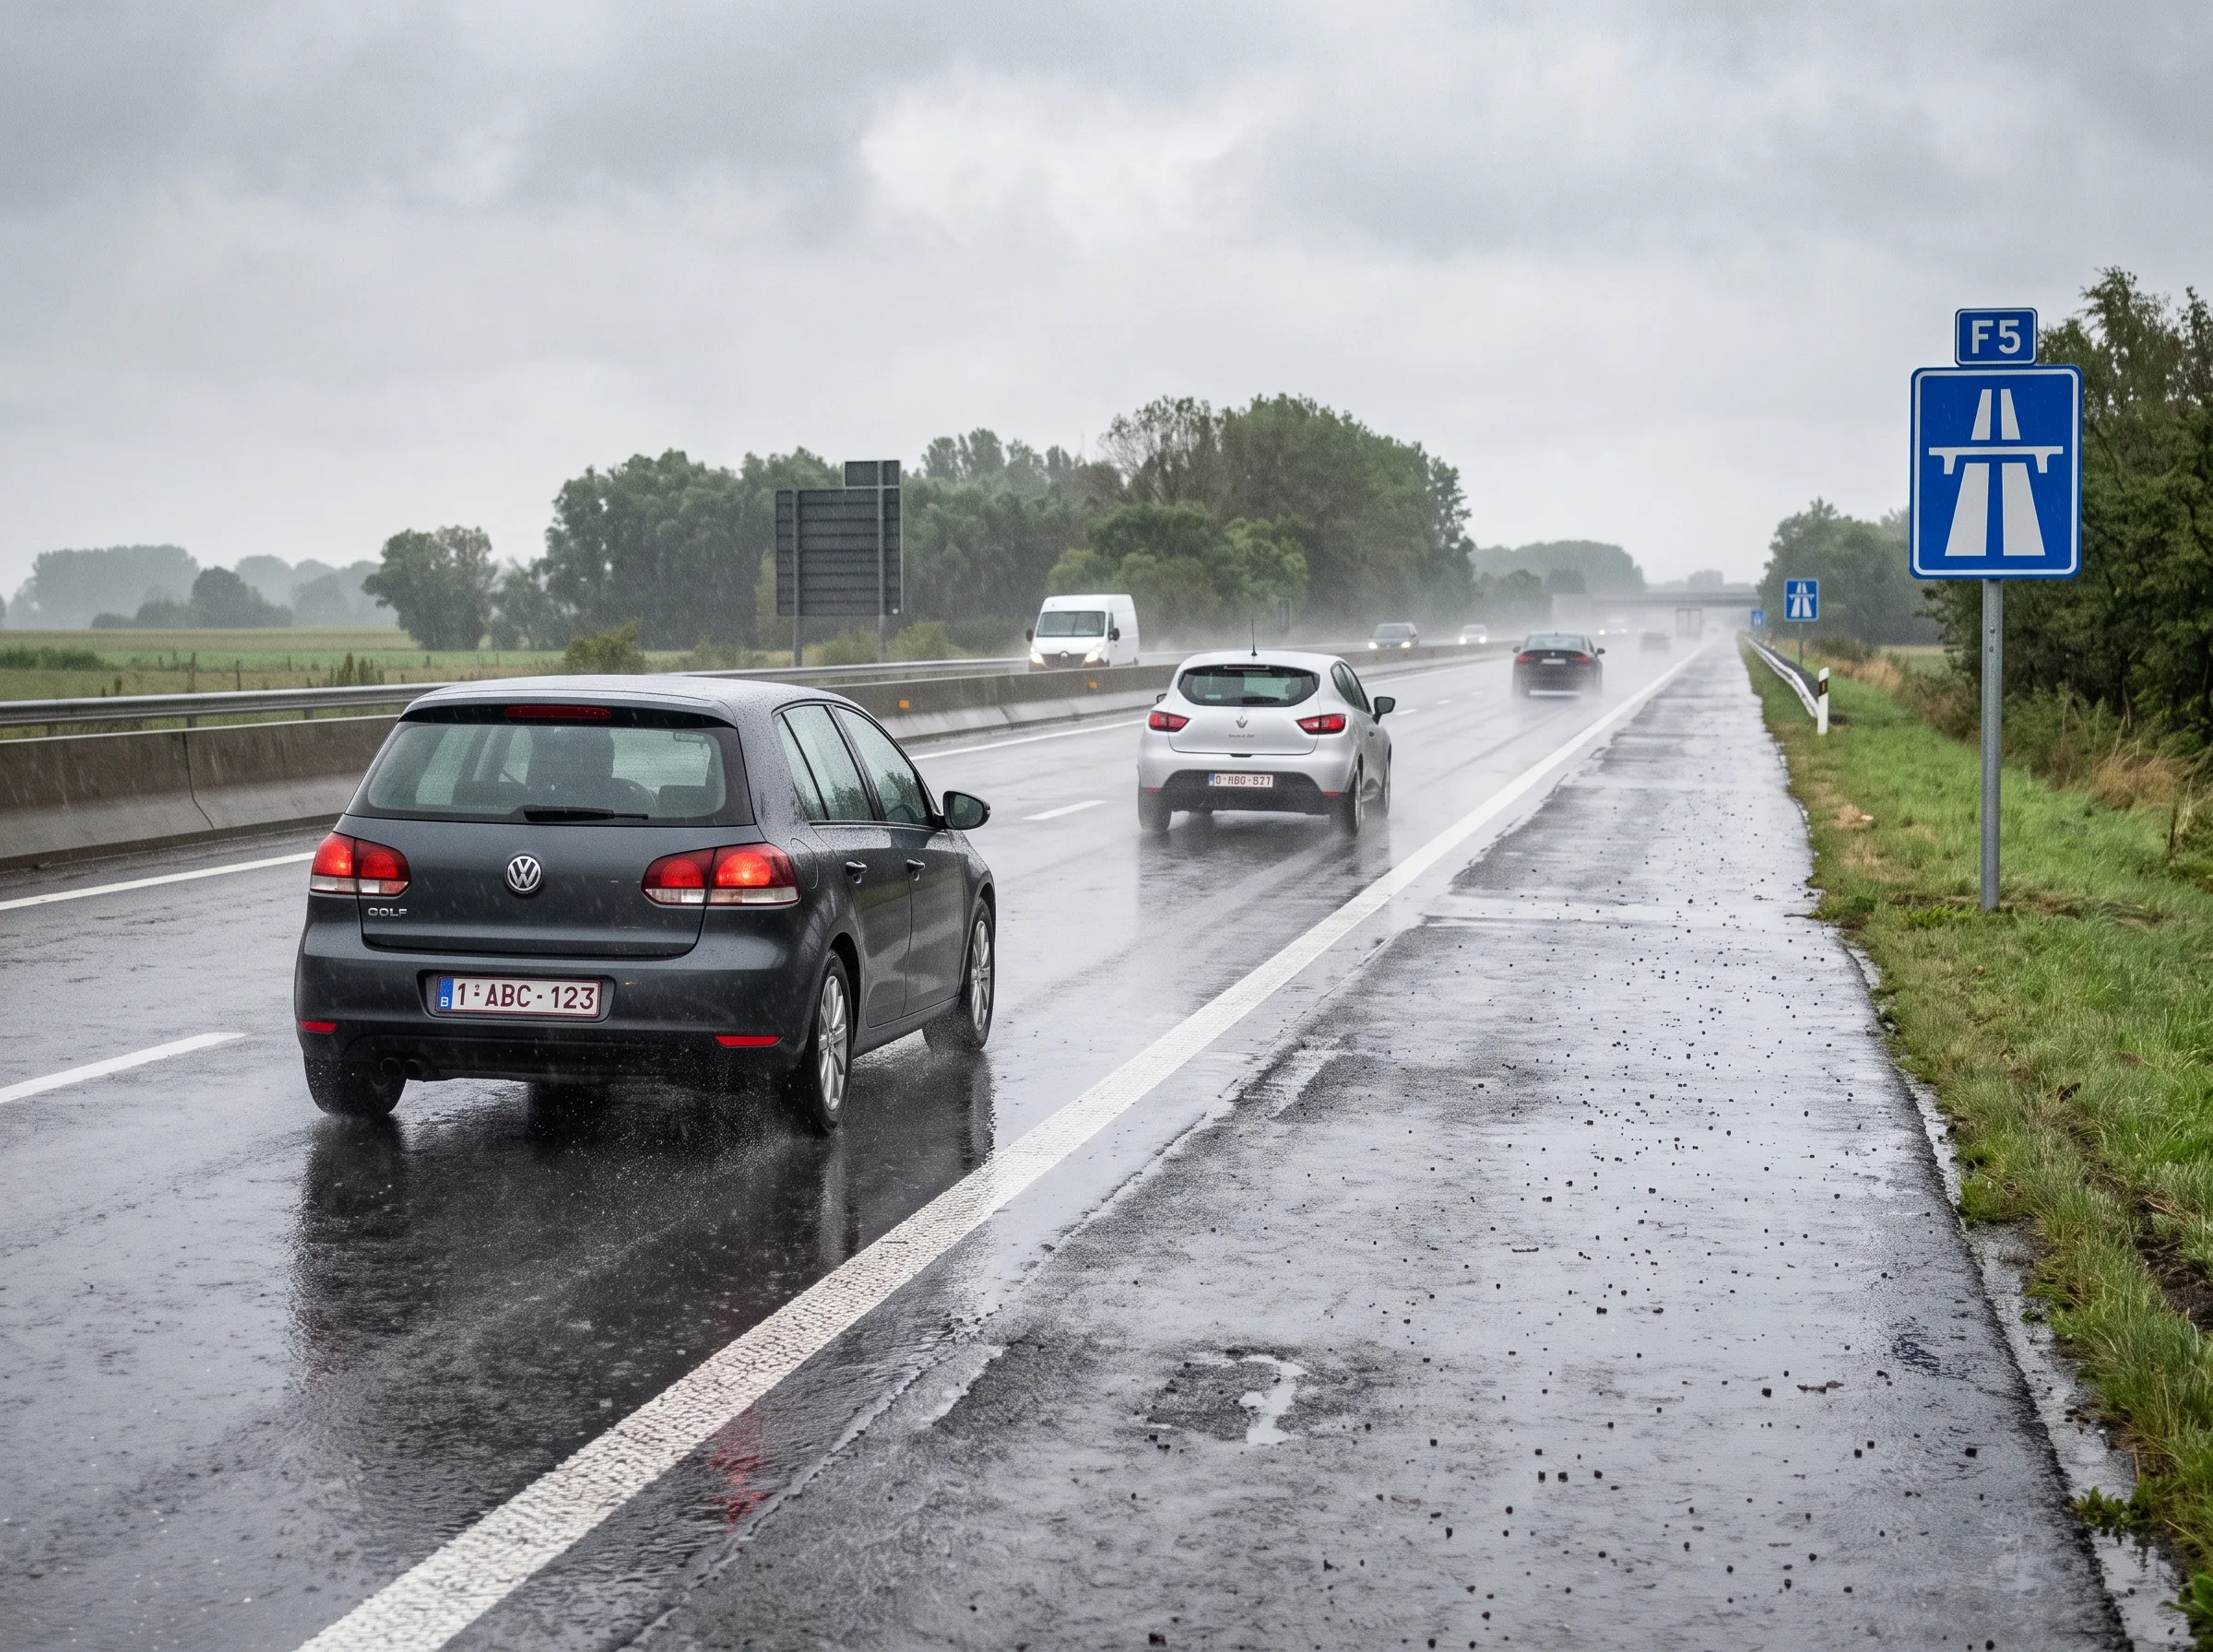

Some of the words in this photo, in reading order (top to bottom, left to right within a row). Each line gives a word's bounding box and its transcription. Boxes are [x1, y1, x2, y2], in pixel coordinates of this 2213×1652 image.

[1971, 319, 2021, 354] F5
[508, 856, 541, 891] VW
[367, 907, 408, 917] GOLF
[440, 997, 449, 1007] B
